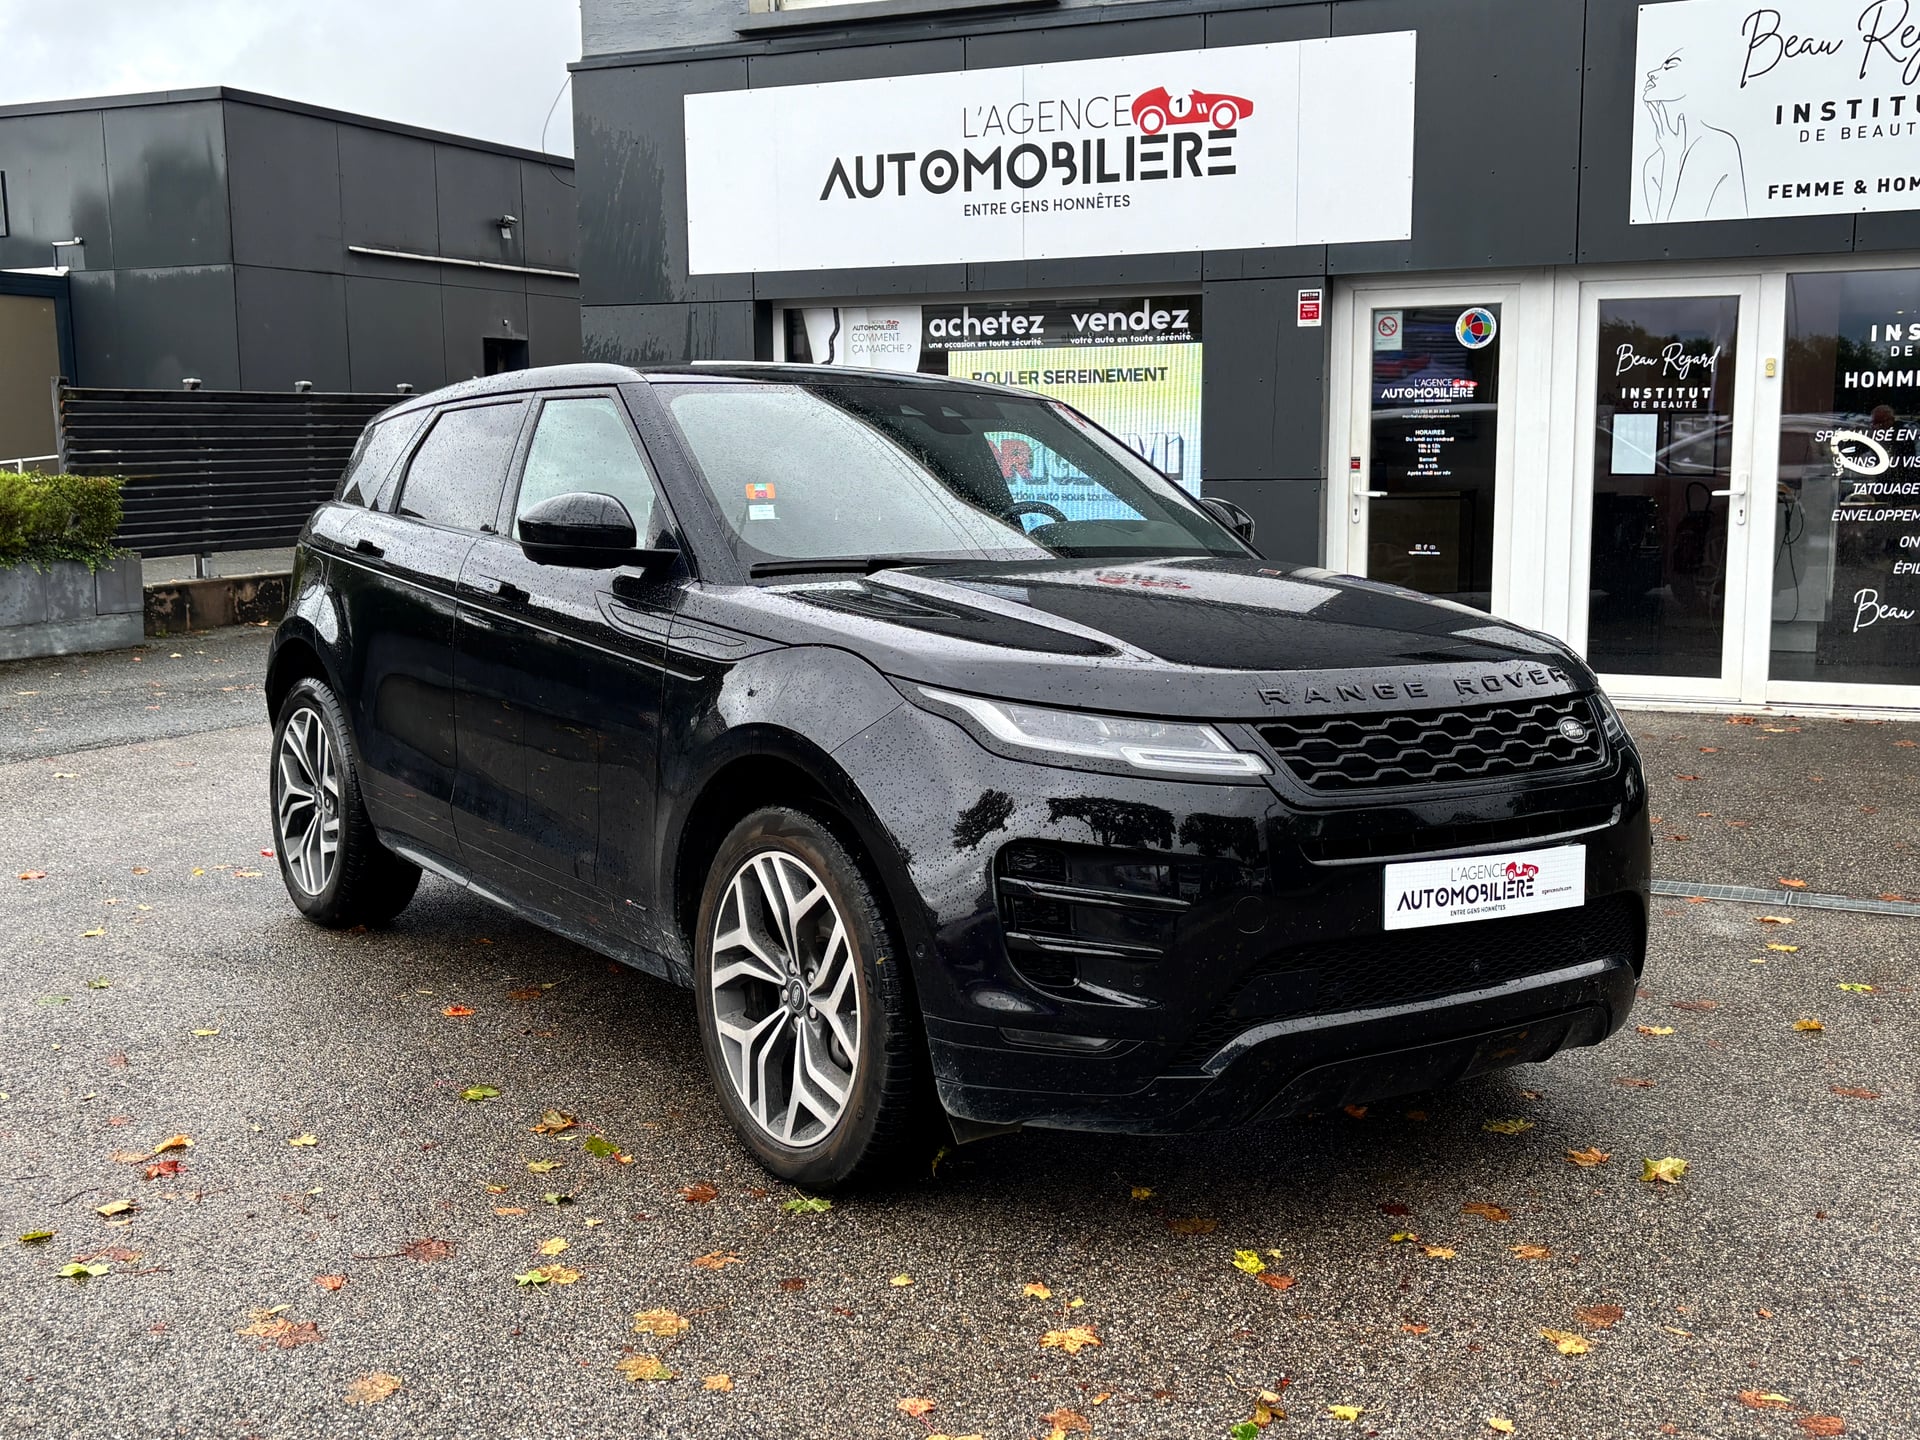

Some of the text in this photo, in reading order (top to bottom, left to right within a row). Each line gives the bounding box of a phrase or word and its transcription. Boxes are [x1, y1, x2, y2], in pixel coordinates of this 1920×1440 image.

[1740, 9, 1843, 89] Beau
[1175, 97, 1183, 113] 1
[1776, 95, 1920, 125] INSTIT
[963, 94, 1132, 138] L'AGENCE
[1800, 121, 1917, 143] DE BEAUT
[1768, 180, 1845, 200] FEMME
[1854, 179, 1867, 194] &
[964, 192, 1131, 217] ENTRE GENS HONNÊTES
[929, 306, 1045, 337] achetez
[1071, 299, 1190, 332] vendez
[851, 332, 901, 342] COMMENT
[1094, 336, 1115, 344] auto
[1130, 334, 1154, 343] toute
[1871, 323, 1920, 342] INS
[851, 344, 864, 355] ÇA
[866, 343, 905, 353] MARCHE
[944, 339, 976, 348] occasion
[989, 338, 1009, 347] toute
[1890, 345, 1914, 357] DE
[1616, 342, 1721, 380] Beau Regard
[1043, 366, 1168, 385] SEREINEMENT
[1414, 378, 1452, 387] L'AGENCE
[1621, 387, 1712, 399] INSTITUT
[1633, 399, 1698, 409] DE BEAUTÉ
[1815, 427, 1917, 442] SPLISÉ EN
[1036, 492, 1060, 501] auto
[1061, 493, 1086, 501] sous
[1853, 482, 1920, 495] TATOUAGE
[1899, 536, 1920, 548] ON
[1853, 588, 1915, 633] Beau
[1257, 666, 1569, 706] RANGE ROVER
[1451, 862, 1507, 882] L'AGENCE
[1450, 909, 1466, 917] ENTRE
